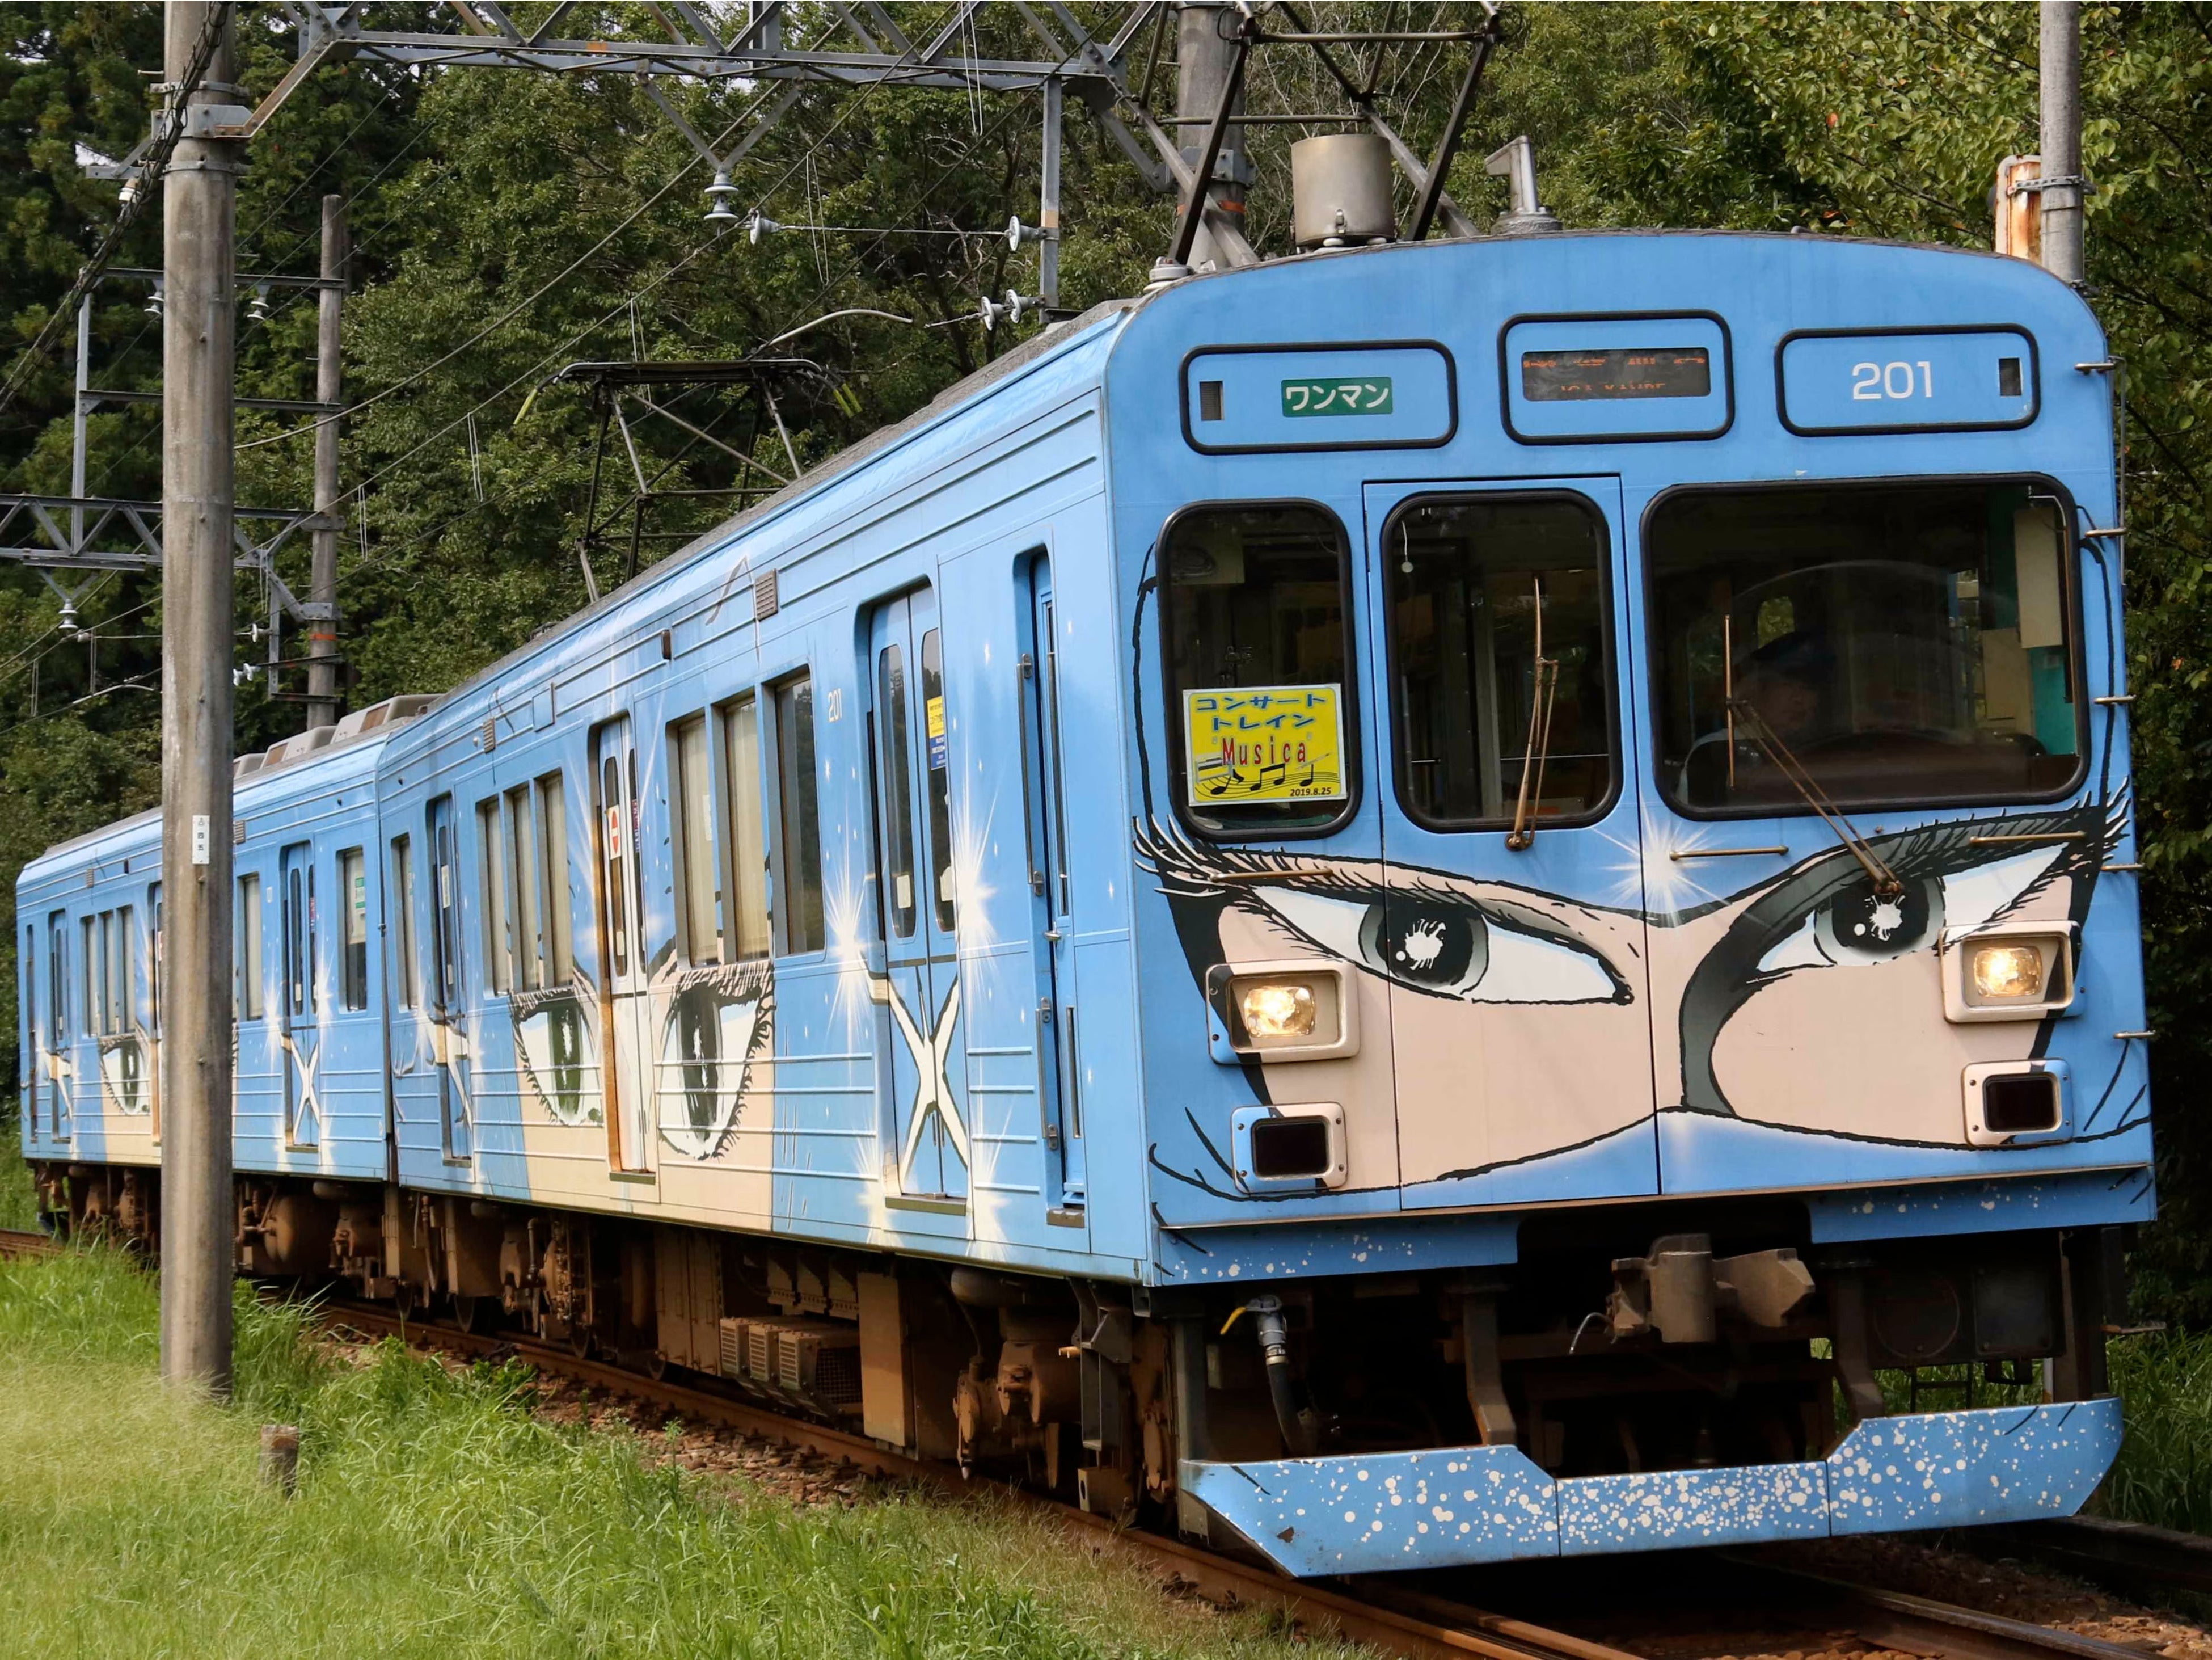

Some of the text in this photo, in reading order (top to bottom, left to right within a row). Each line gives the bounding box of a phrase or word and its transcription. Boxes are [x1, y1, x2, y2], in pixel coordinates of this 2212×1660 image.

[1852, 361, 1932, 399] 201
[1286, 384, 1388, 411] ワンマン
[828, 688, 842, 722] 201
[1197, 693, 1326, 711] コンサート
[1212, 714, 1315, 731] トレイン
[1222, 736, 1306, 766] Musica
[1290, 787, 1332, 797] 2019.8.25
